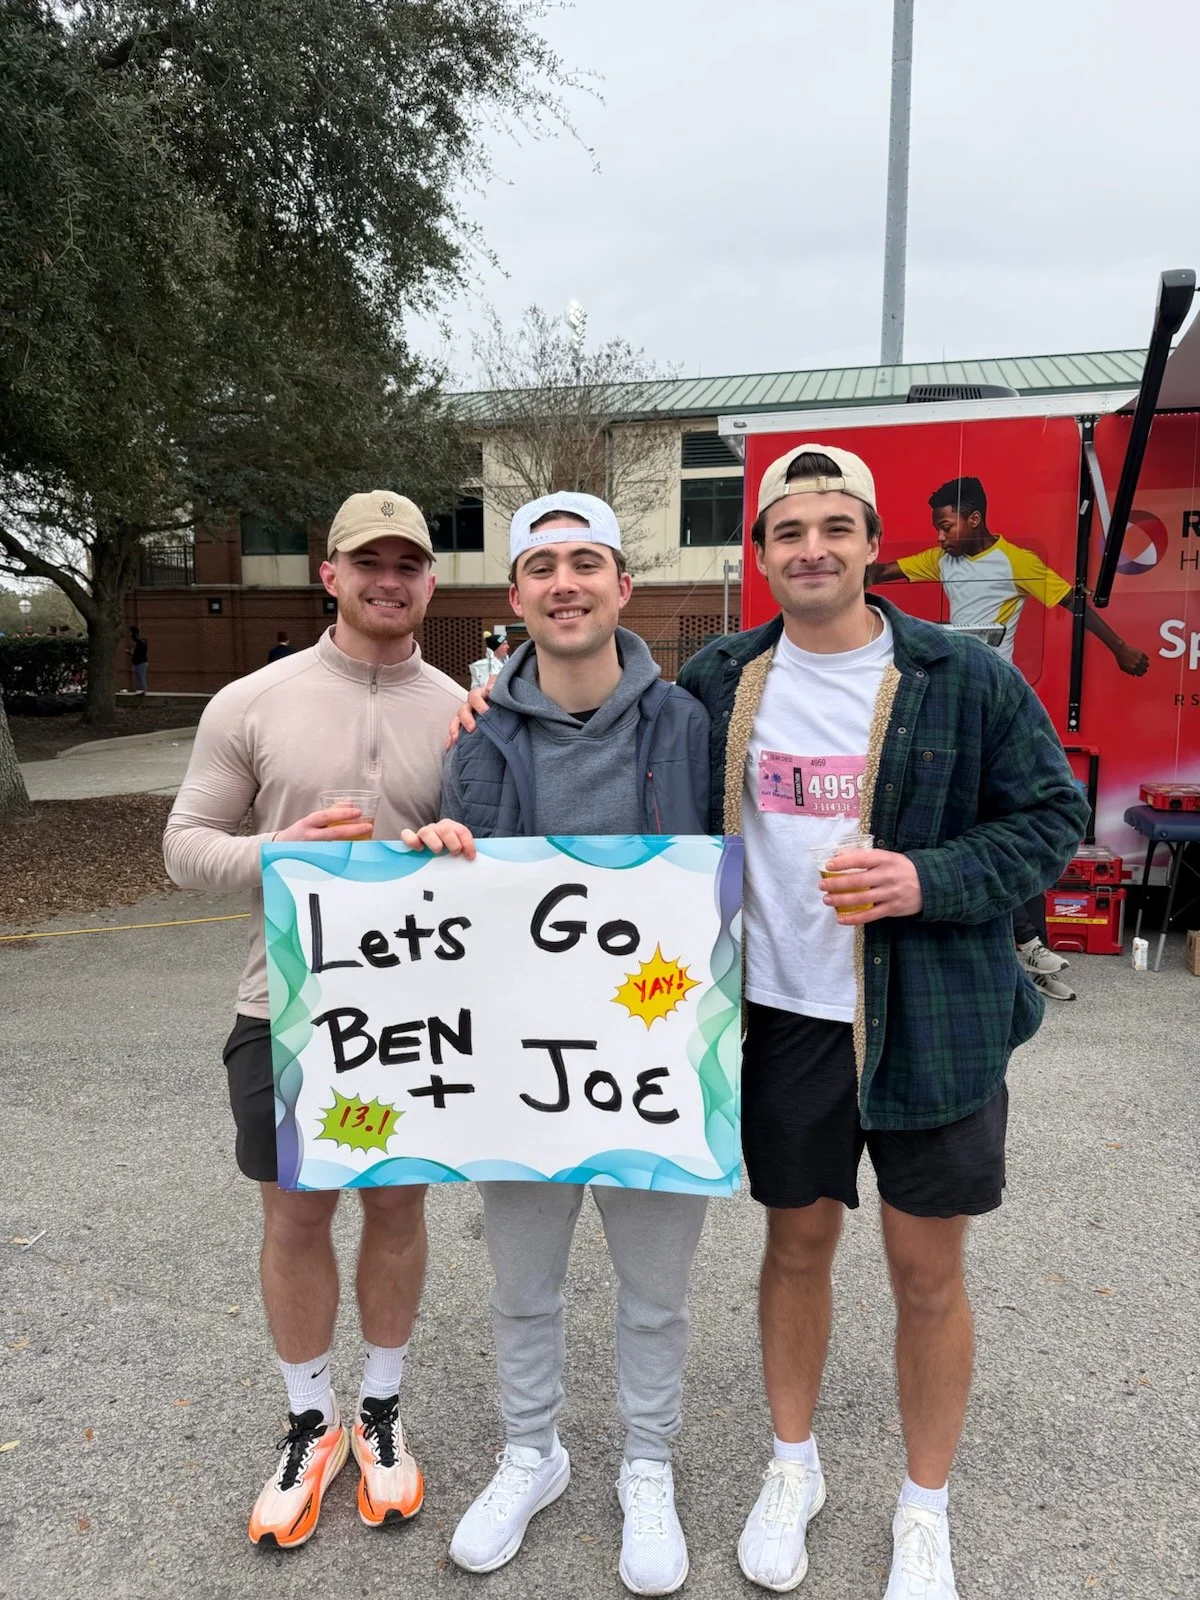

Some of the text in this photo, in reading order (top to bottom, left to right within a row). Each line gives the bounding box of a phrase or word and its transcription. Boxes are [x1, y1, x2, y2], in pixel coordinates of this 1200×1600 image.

[1180, 550, 1199, 571] H
[309, 883, 641, 974] Let's Go
[633, 969, 684, 1003] YAY!
[310, 1006, 473, 1074] BEN
[406, 1039, 680, 1125] + JOE
[339, 1105, 391, 1135] 13.1
